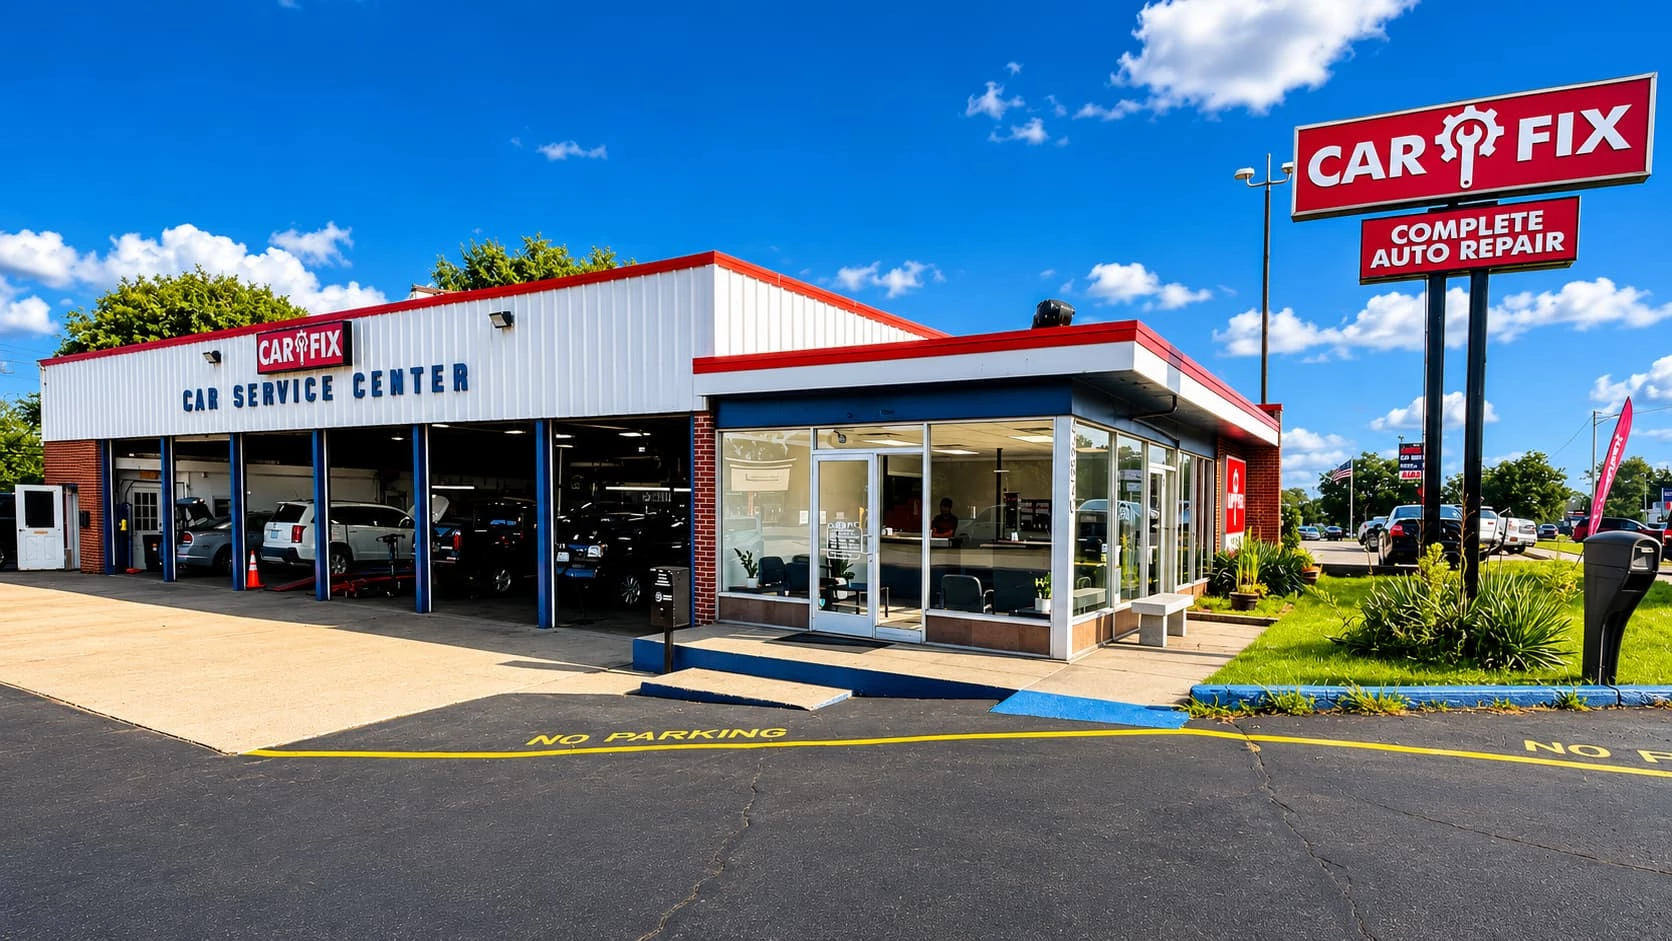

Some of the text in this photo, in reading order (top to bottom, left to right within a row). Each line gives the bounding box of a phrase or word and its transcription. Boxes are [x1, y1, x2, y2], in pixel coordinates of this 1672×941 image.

[1307, 104, 1633, 187] CAR FIX
[1391, 210, 1544, 245] COMPLETE
[1370, 231, 1565, 269] AUTO REPAIR
[258, 329, 343, 366] CAR FIX
[182, 363, 468, 412] CAR SERVICE CENTER
[525, 728, 788, 746] NO PARKING
[1523, 739, 1612, 758] NO
